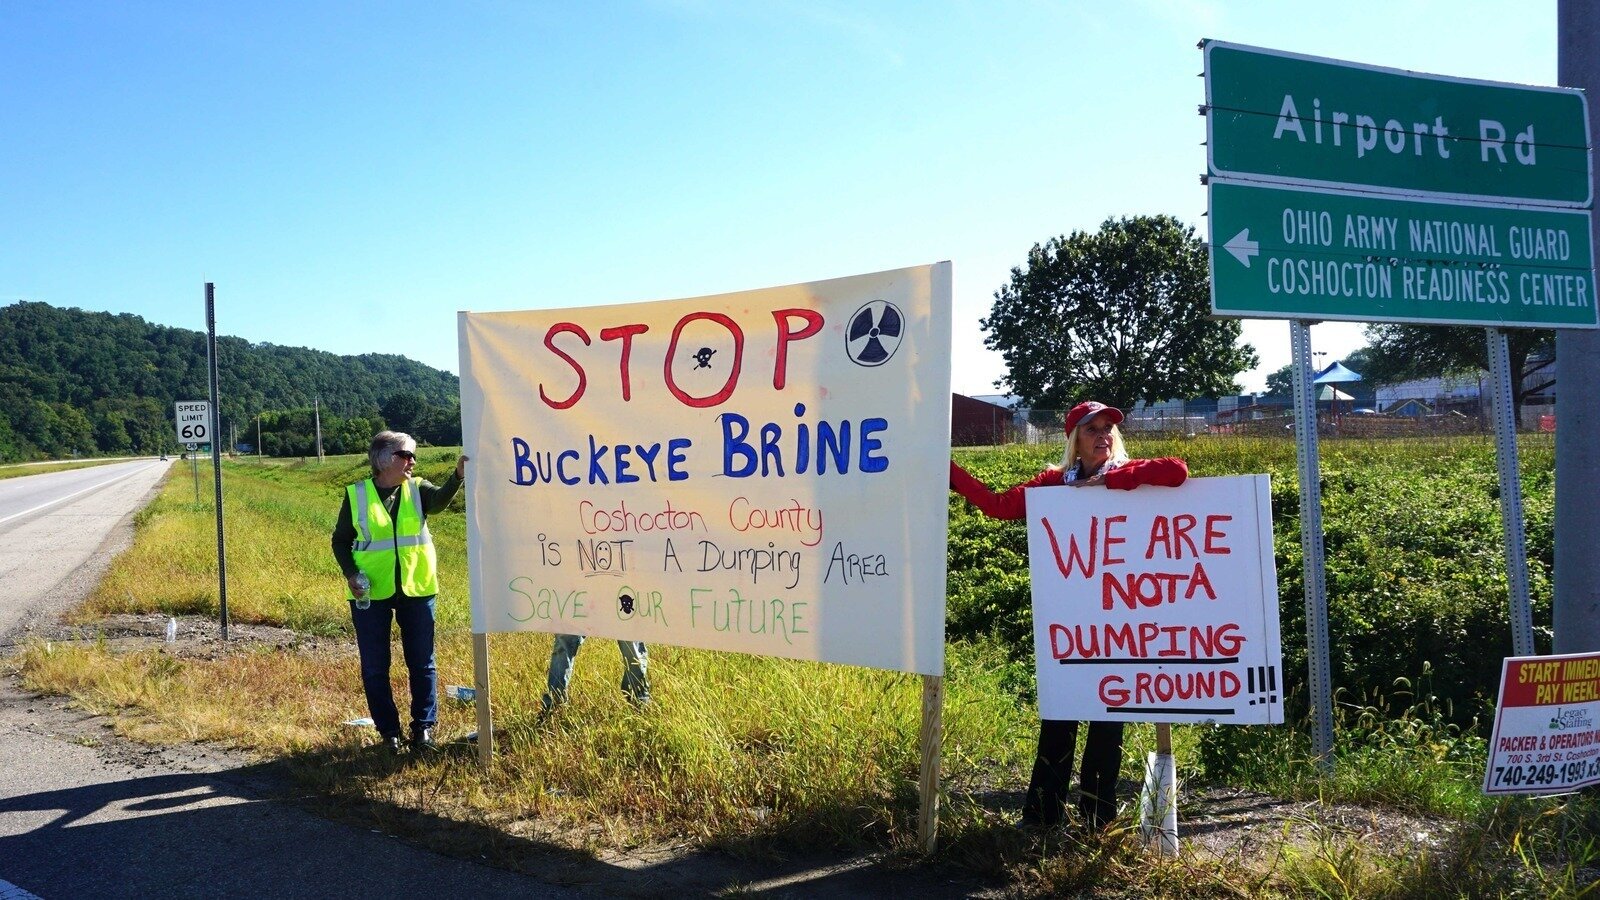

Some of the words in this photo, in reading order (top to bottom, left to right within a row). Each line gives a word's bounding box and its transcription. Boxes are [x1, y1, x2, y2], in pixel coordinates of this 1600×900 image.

[1273, 94, 1450, 159] Airport
[1479, 119, 1537, 165] Rd
[1282, 207, 1333, 247] OHIO
[1344, 213, 1398, 252] ARMY
[1409, 219, 1502, 257] NATIONAL
[1509, 225, 1570, 261] GUARD
[1267, 257, 1393, 299] COSHOCTON
[1402, 266, 1510, 305] READINESS
[1519, 272, 1588, 307] CENTER
[539, 308, 825, 410] STOP
[182, 425, 205, 438] 60
[509, 434, 692, 486] BUCKEYE
[579, 500, 706, 534] Coshocton
[729, 496, 824, 546] County
[577, 539, 634, 573] NOT
[664, 538, 683, 573] A
[697, 541, 801, 590] Dumping
[1041, 516, 1127, 579] WE
[1145, 514, 1233, 560] ARE
[1049, 623, 1246, 659] DUMPING
[1519, 662, 1560, 683] START
[1536, 684, 1560, 704] PAY
[1556, 707, 1589, 719] Legacy
[1558, 717, 1592, 730] Staffing
[1500, 736, 1537, 752] PACKER
[1540, 735, 1546, 750] &
[1549, 731, 1594, 750] OPERATORS
[1506, 754, 1523, 764] 700
[1536, 752, 1552, 763] 3rd
[1494, 760, 1586, 787] 740-249-1993
